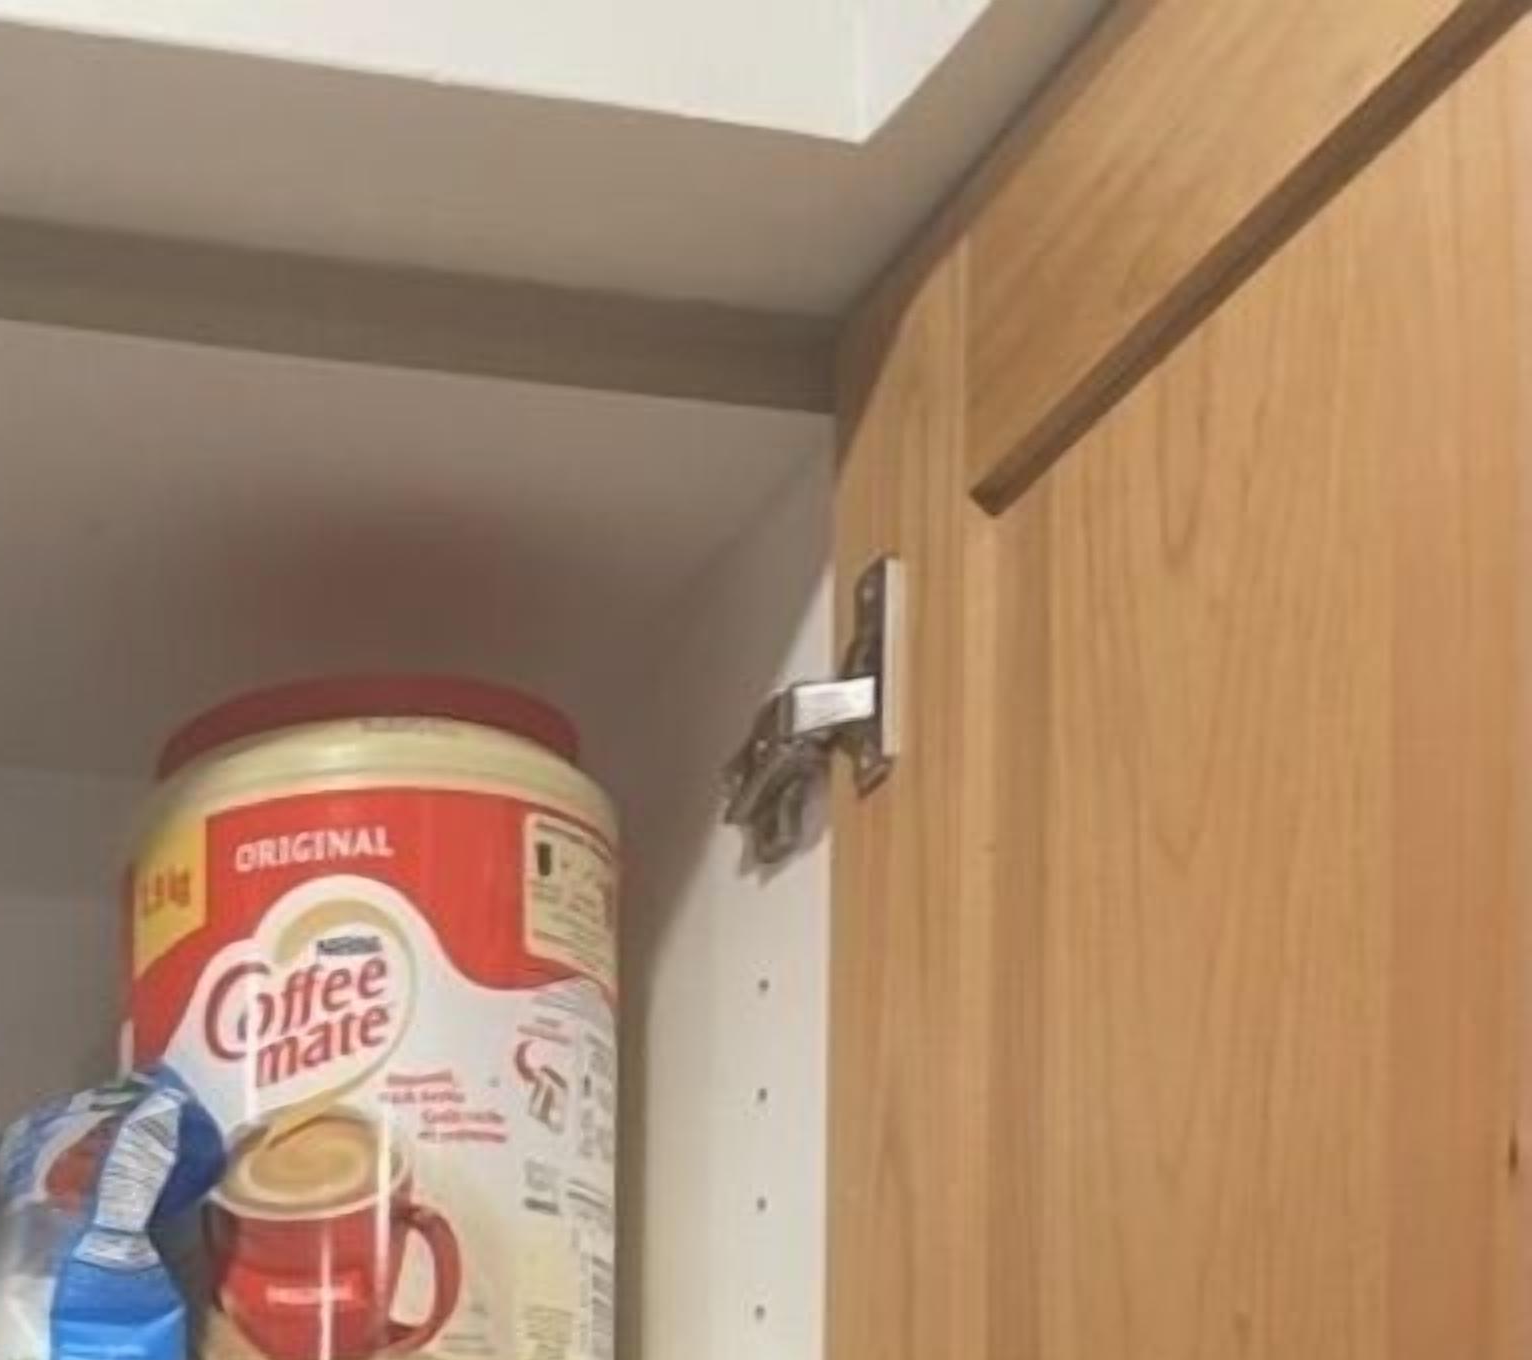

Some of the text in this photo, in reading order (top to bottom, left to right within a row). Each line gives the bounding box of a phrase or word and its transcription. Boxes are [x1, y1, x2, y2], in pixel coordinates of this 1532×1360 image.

[235, 826, 394, 872] ORIGINAL
[205, 956, 389, 1062] Coffee
[255, 1004, 391, 1088] mate
